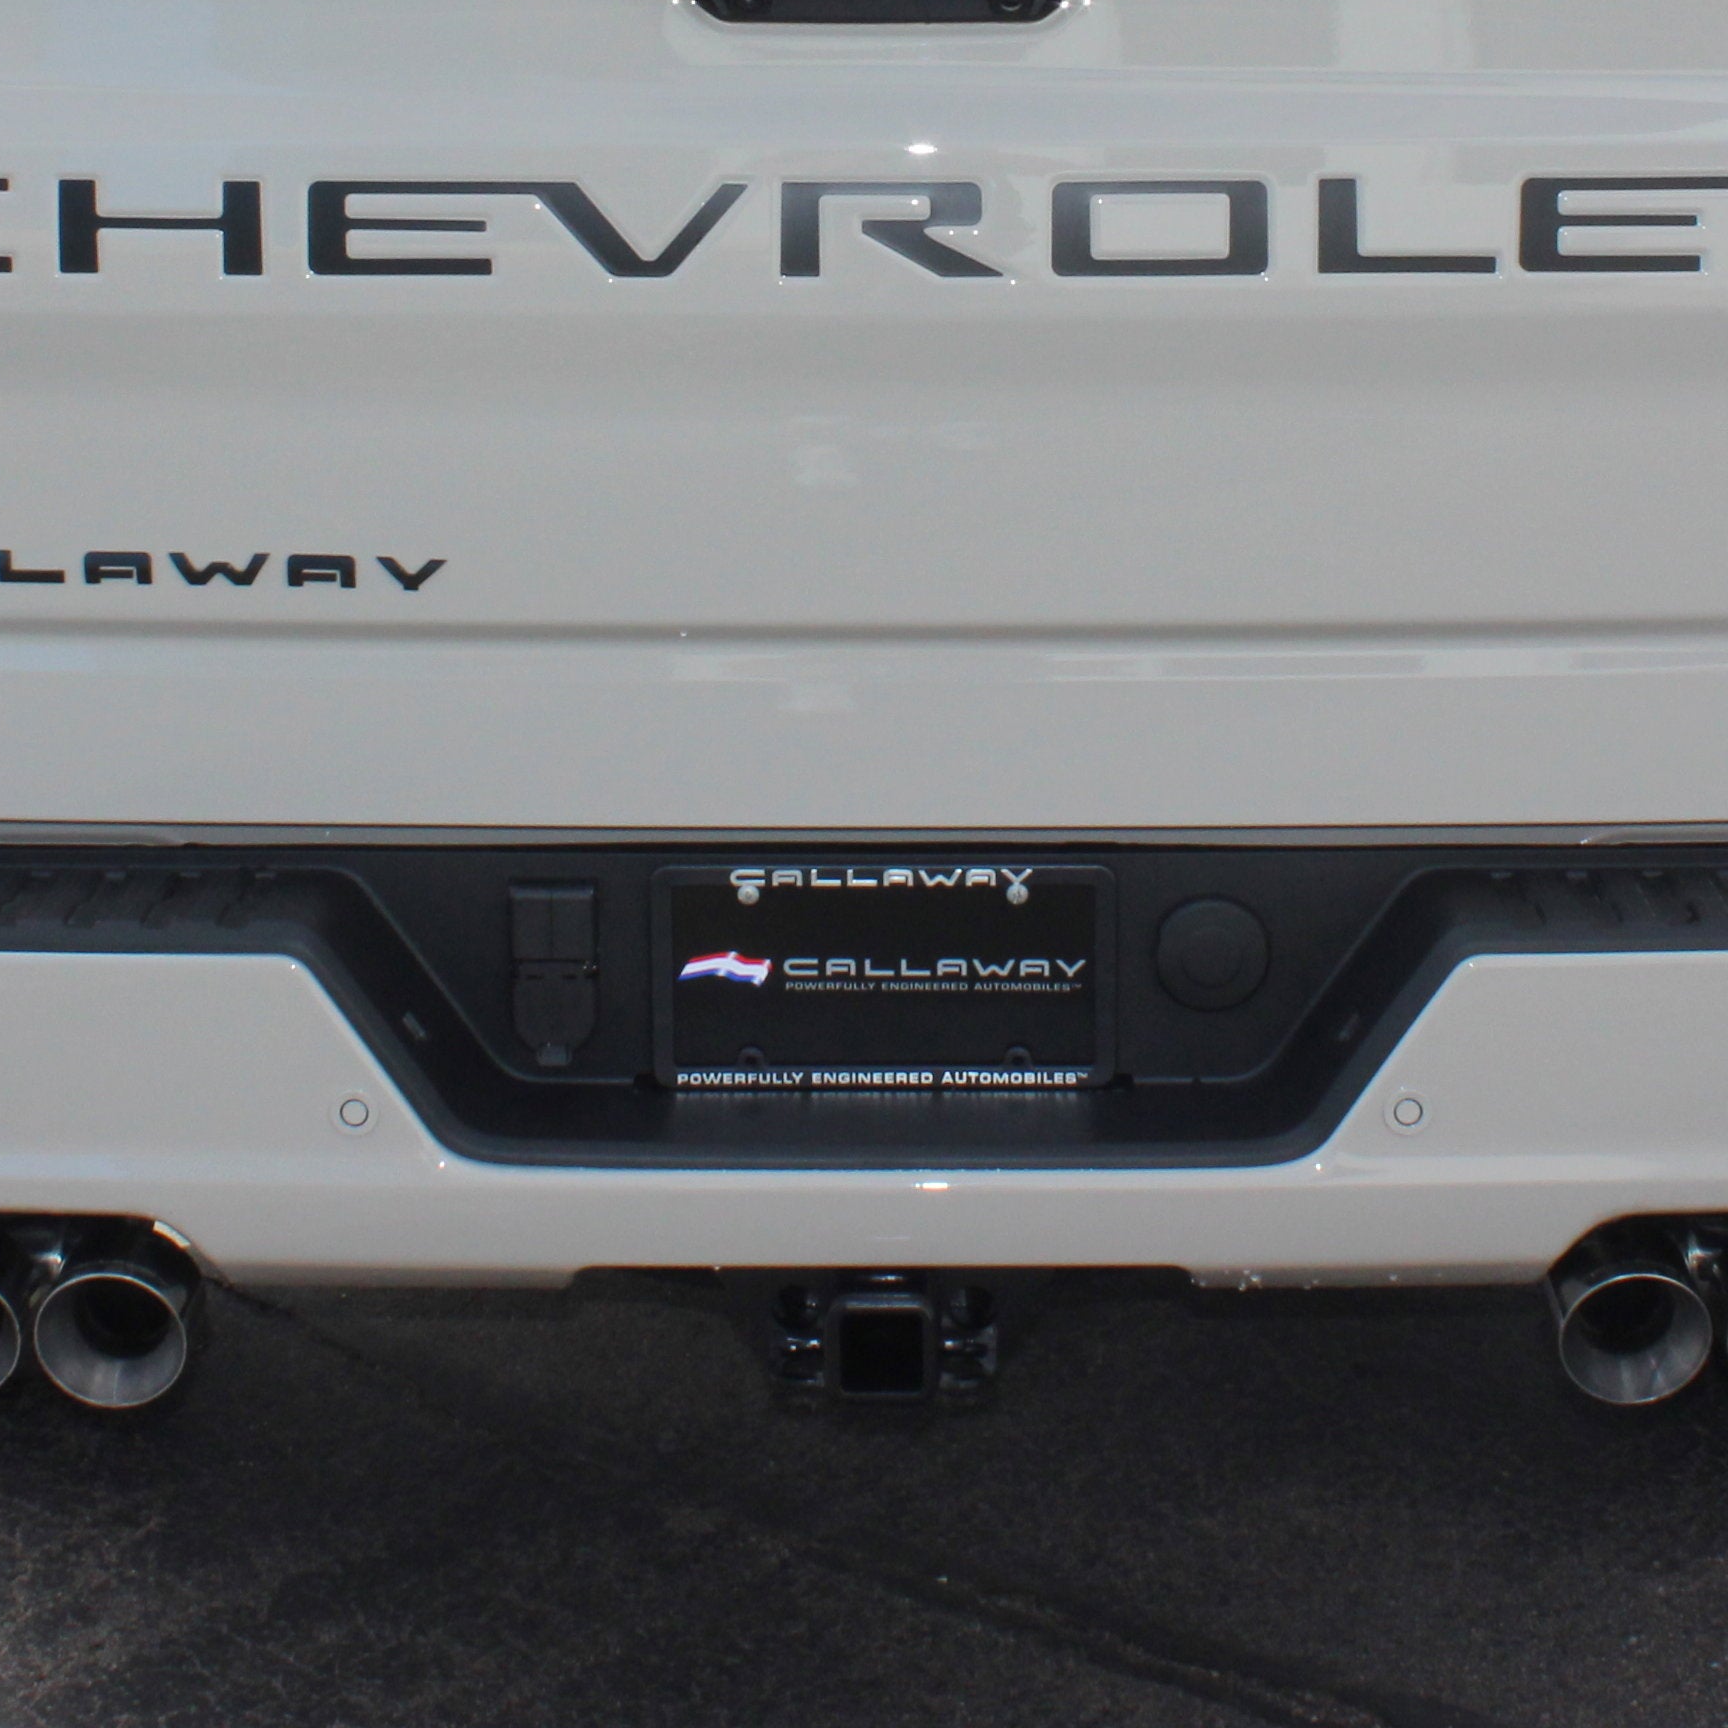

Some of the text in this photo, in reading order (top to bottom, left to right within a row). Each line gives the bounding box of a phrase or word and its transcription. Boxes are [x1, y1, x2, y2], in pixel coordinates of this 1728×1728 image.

[729, 868, 1033, 888] CALLAWAY
[783, 958, 1086, 977] CALLAWAY
[785, 981, 876, 991] POWERFULLY
[881, 981, 969, 991] ENGINEERED
[677, 1072, 804, 1085] POWERFULLY
[811, 1072, 934, 1085] ENGINEERED
